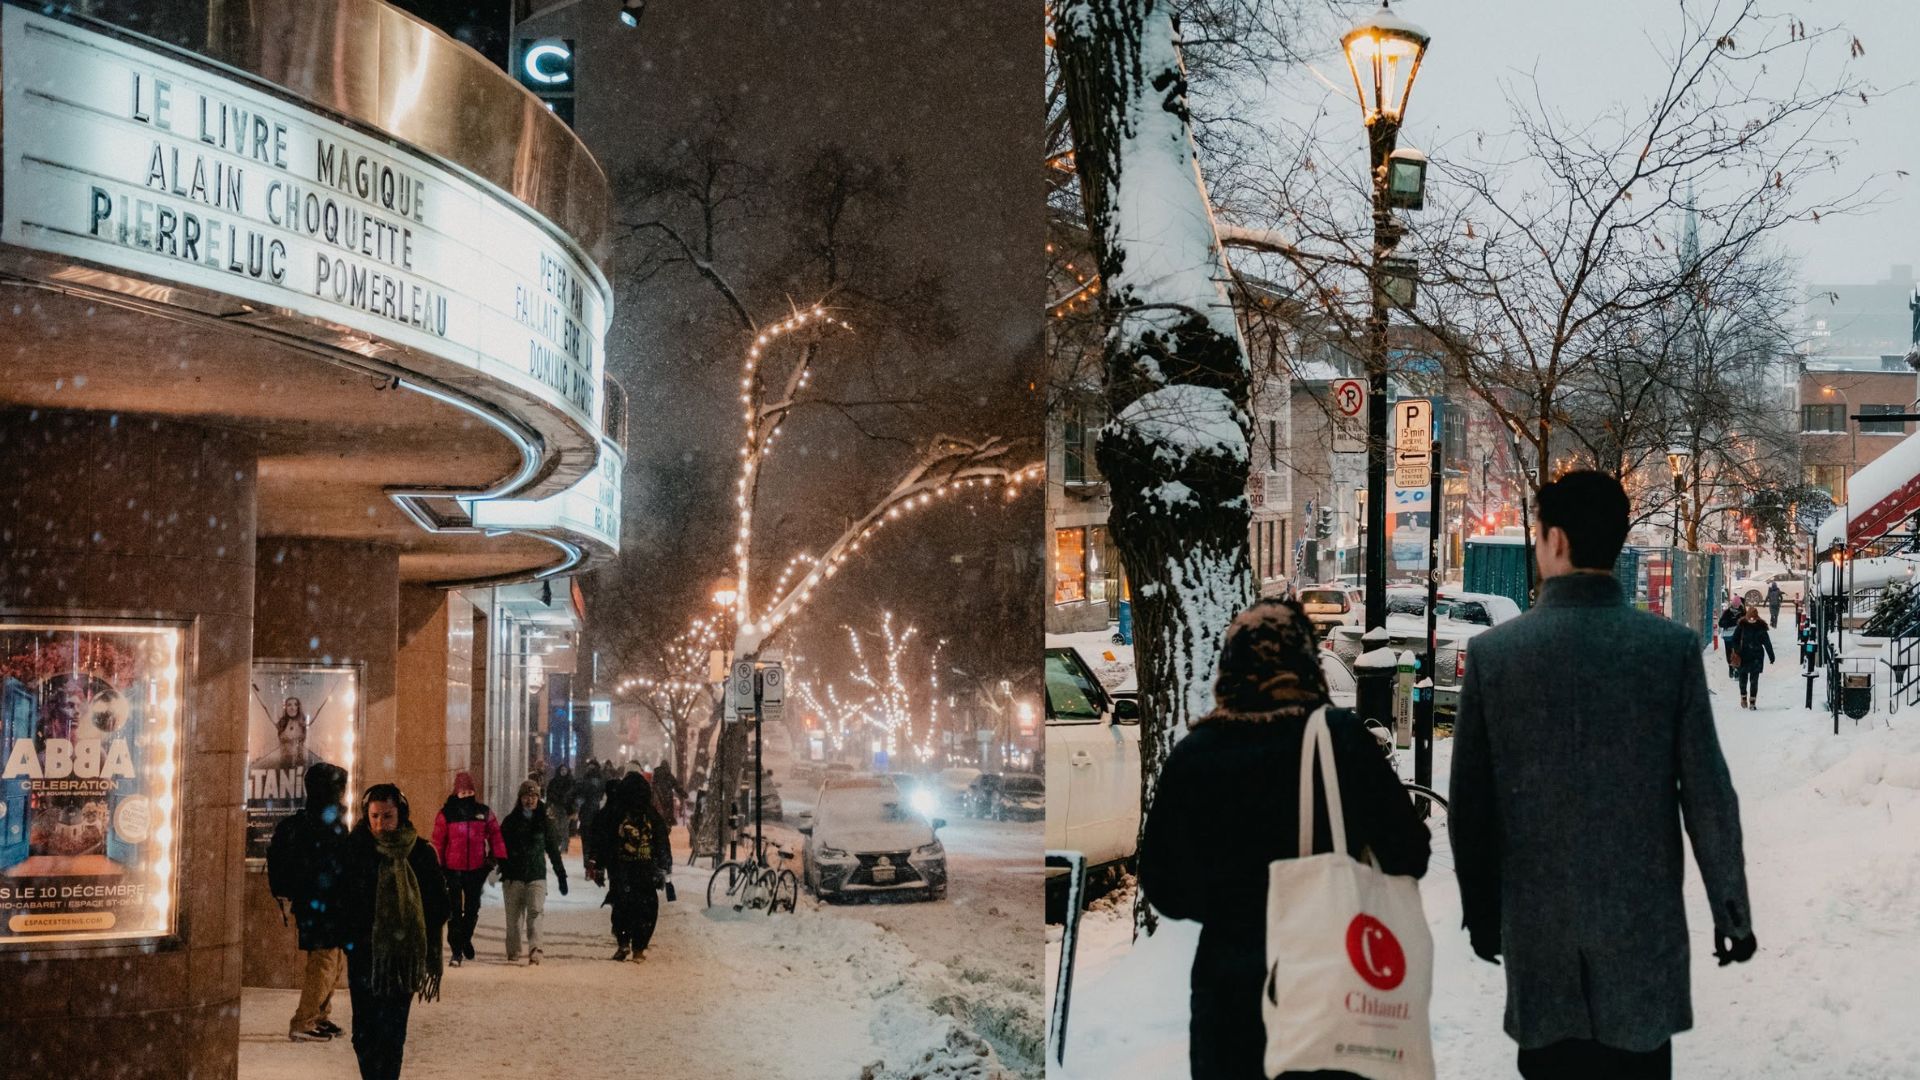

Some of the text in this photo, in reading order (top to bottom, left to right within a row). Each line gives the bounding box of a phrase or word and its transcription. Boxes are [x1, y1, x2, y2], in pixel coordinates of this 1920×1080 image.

[525, 45, 570, 83] C
[132, 71, 425, 223] LE LIVRE MAGIQUE
[145, 140, 413, 270] ALAIN CHOQUETTE
[89, 185, 448, 337] PIERRELUC POMERLEAU
[540, 250, 567, 304] PETER
[515, 282, 559, 343] FALLAIT
[530, 339, 569, 397] DOMINIC
[1401, 429, 1425, 438] 15 min
[1406, 406, 1419, 428] P
[2, 738, 136, 779] ABBA
[21, 780, 119, 791] CELEBRATION
[15, 887, 35, 899] LE
[40, 887, 57, 898] 10
[61, 884, 145, 897] DÉCEMBRE
[68, 899, 104, 908] ESPACE
[1345, 991, 1409, 1019] Chianti
